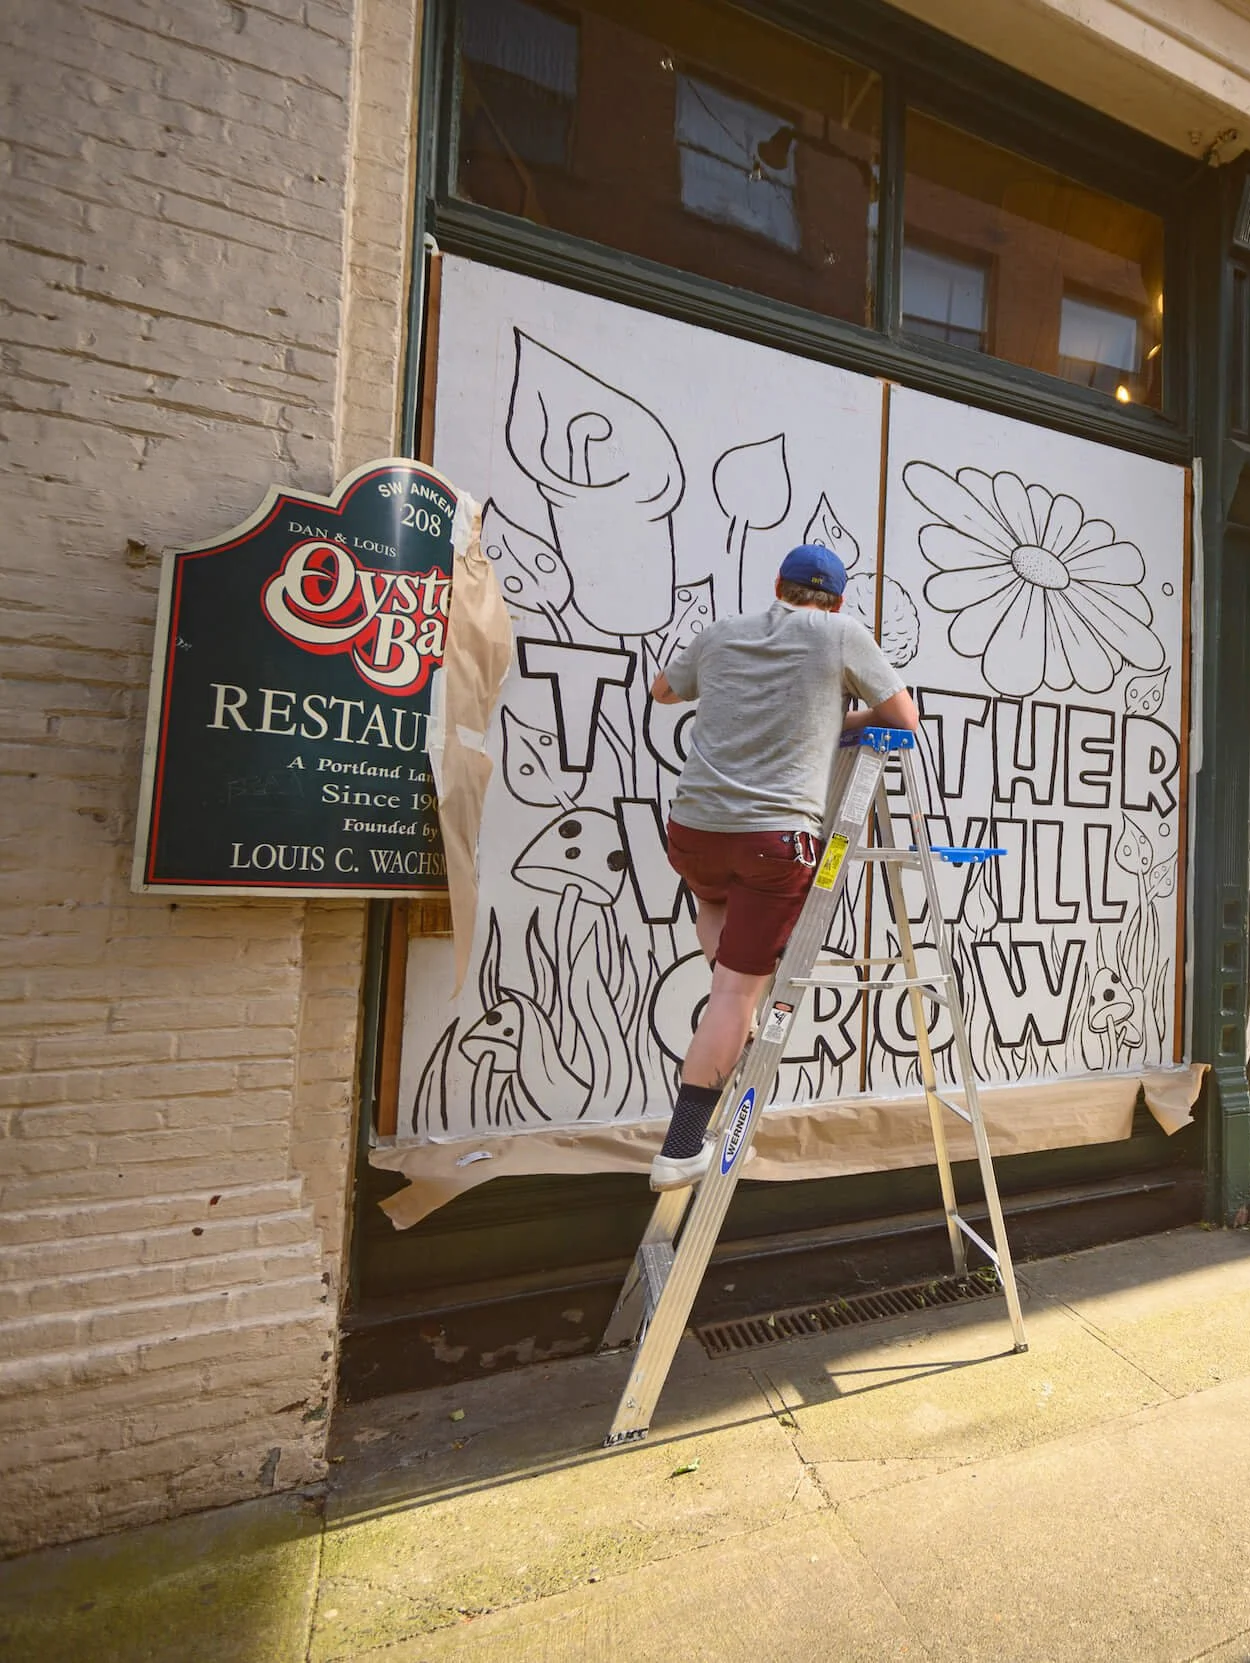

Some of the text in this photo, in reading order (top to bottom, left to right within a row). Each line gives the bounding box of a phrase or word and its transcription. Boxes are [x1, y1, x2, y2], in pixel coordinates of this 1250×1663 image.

[378, 481, 454, 518] SW ANKEN
[401, 503, 441, 537] 208
[289, 521, 397, 557] DAN & LOUIS
[265, 541, 453, 644] Oyst
[353, 612, 445, 687] Ba
[206, 682, 430, 754] RESTAU
[287, 755, 434, 783] A Portland Lan
[321, 783, 439, 812] Since 19
[343, 818, 438, 843] Founded by
[229, 842, 325, 873] LOUIS
[335, 847, 359, 873] C.
[874, 812, 1128, 925] WILL
[726, 1102, 751, 1157] WERNER
